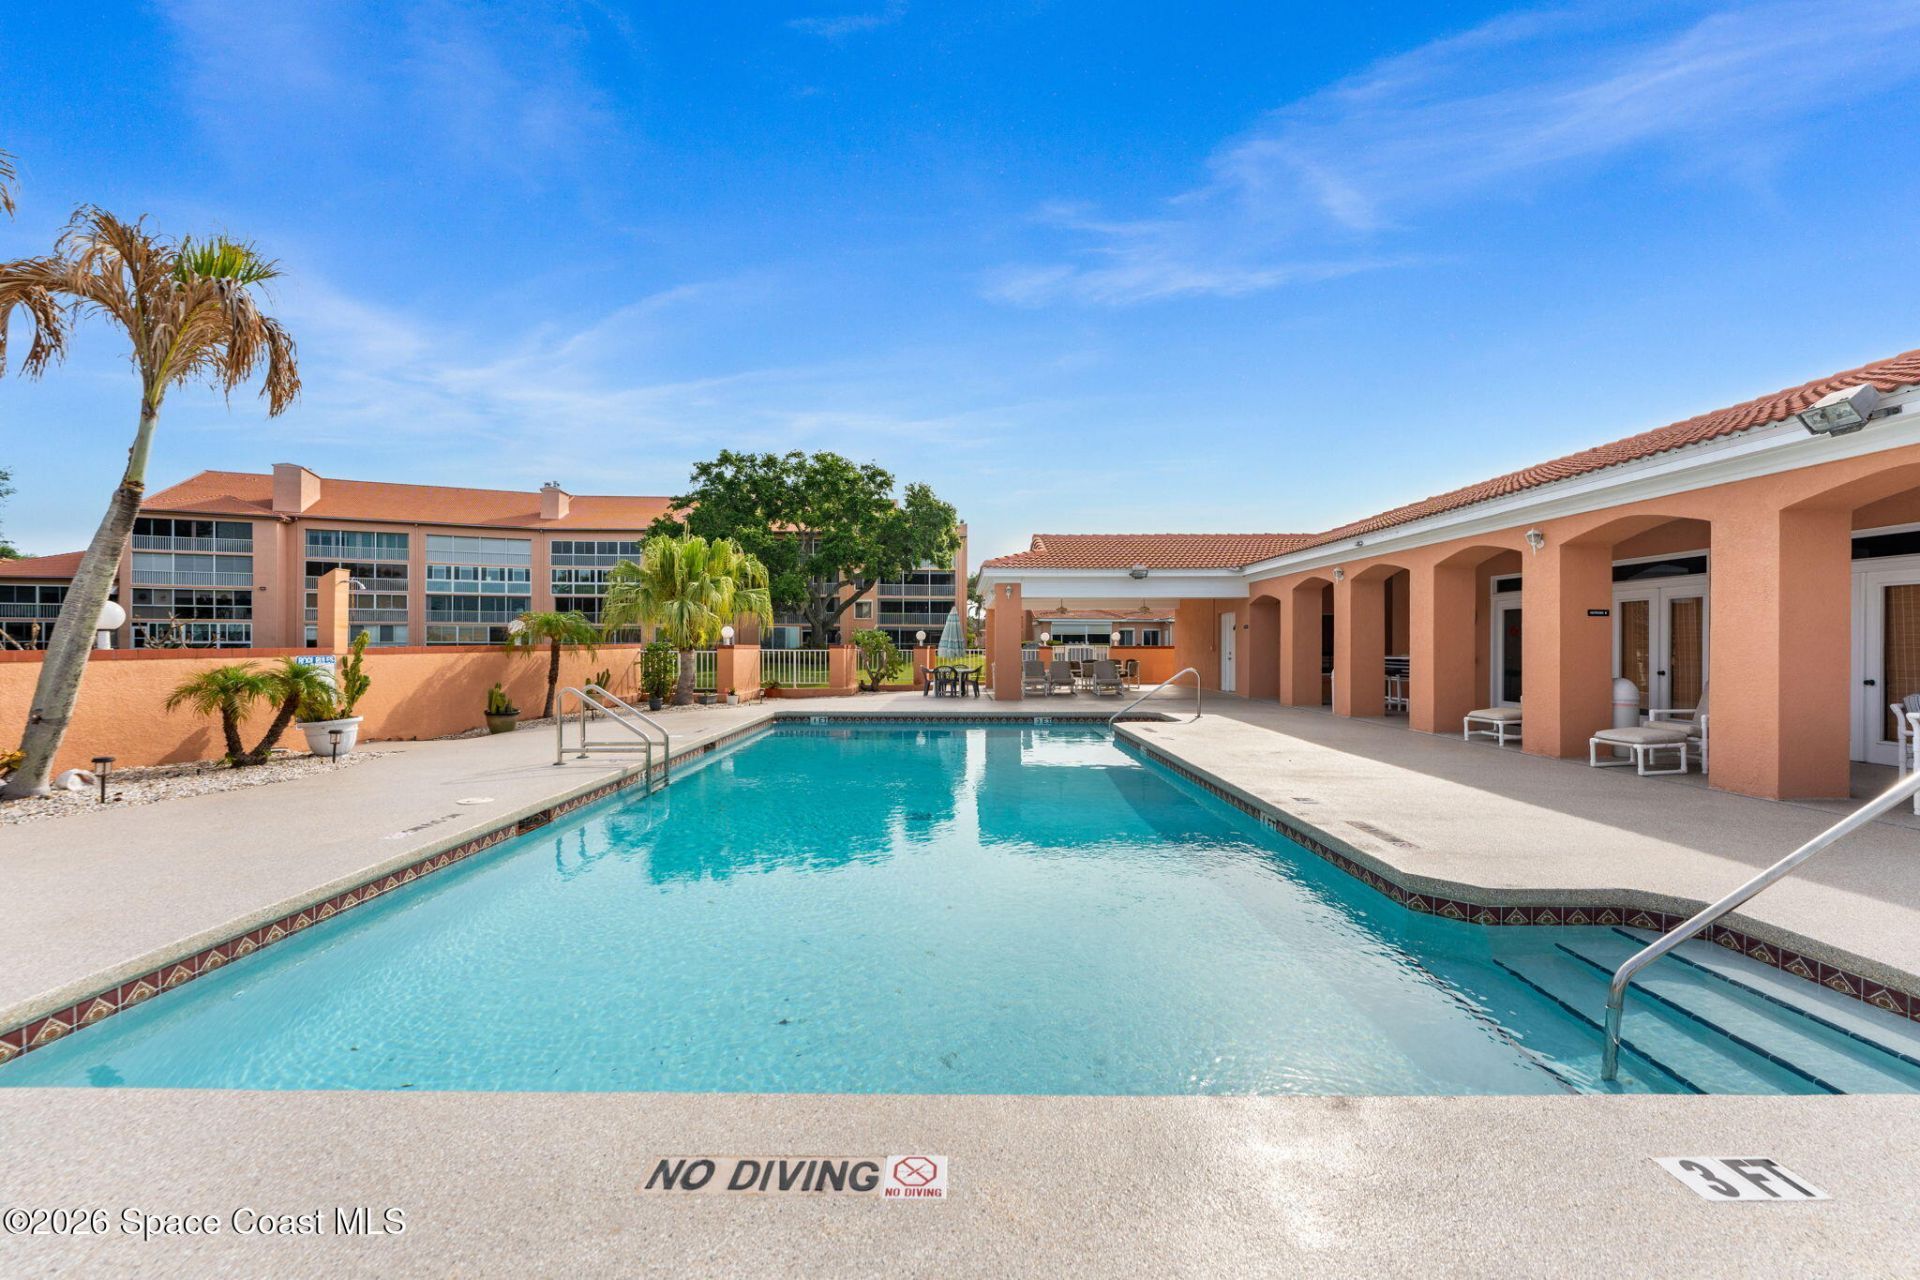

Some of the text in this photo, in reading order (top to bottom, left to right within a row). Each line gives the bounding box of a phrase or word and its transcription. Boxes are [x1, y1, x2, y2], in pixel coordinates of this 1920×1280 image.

[644, 1159, 880, 1192] NO DIVING
[1679, 1159, 1816, 1197] 3 FT
[885, 1188, 942, 1197] NO DIVING
